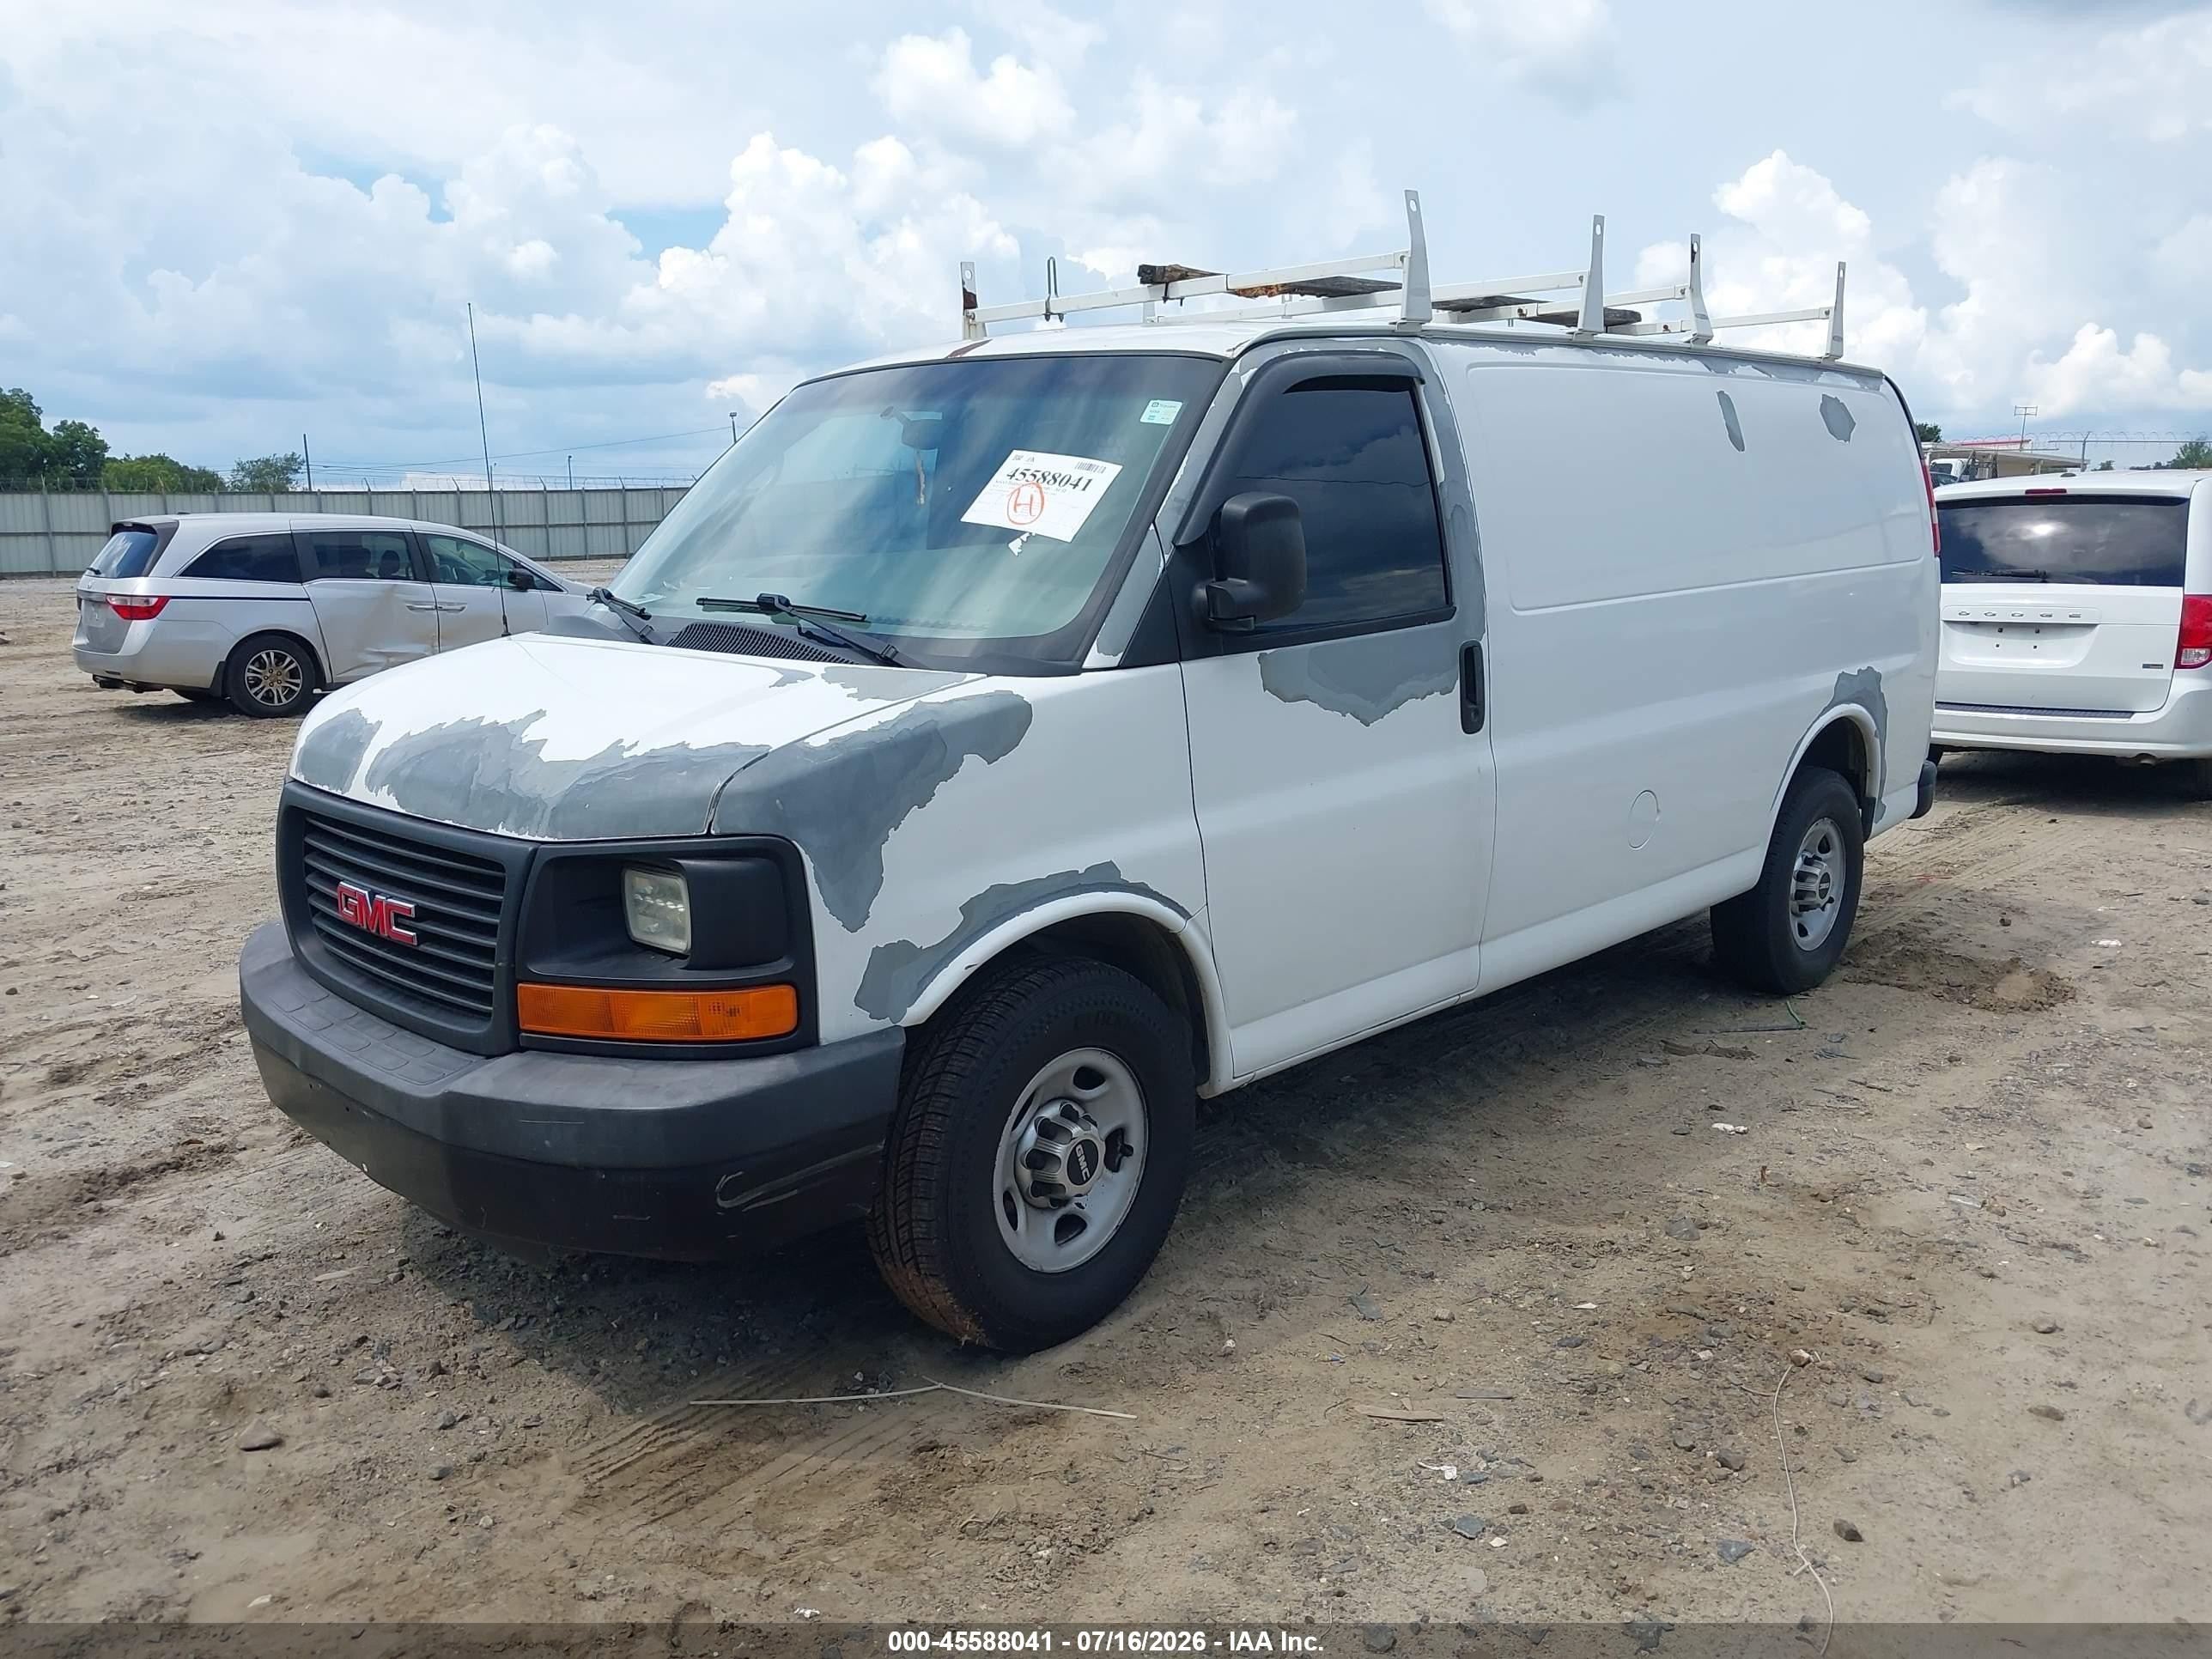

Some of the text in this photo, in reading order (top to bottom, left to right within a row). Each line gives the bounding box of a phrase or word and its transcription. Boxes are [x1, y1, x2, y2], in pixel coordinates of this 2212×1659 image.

[1006, 466, 1094, 492] 45588041
[1013, 487, 1036, 517] H
[337, 881, 418, 946] GMC
[1075, 1143, 1091, 1182] GMC
